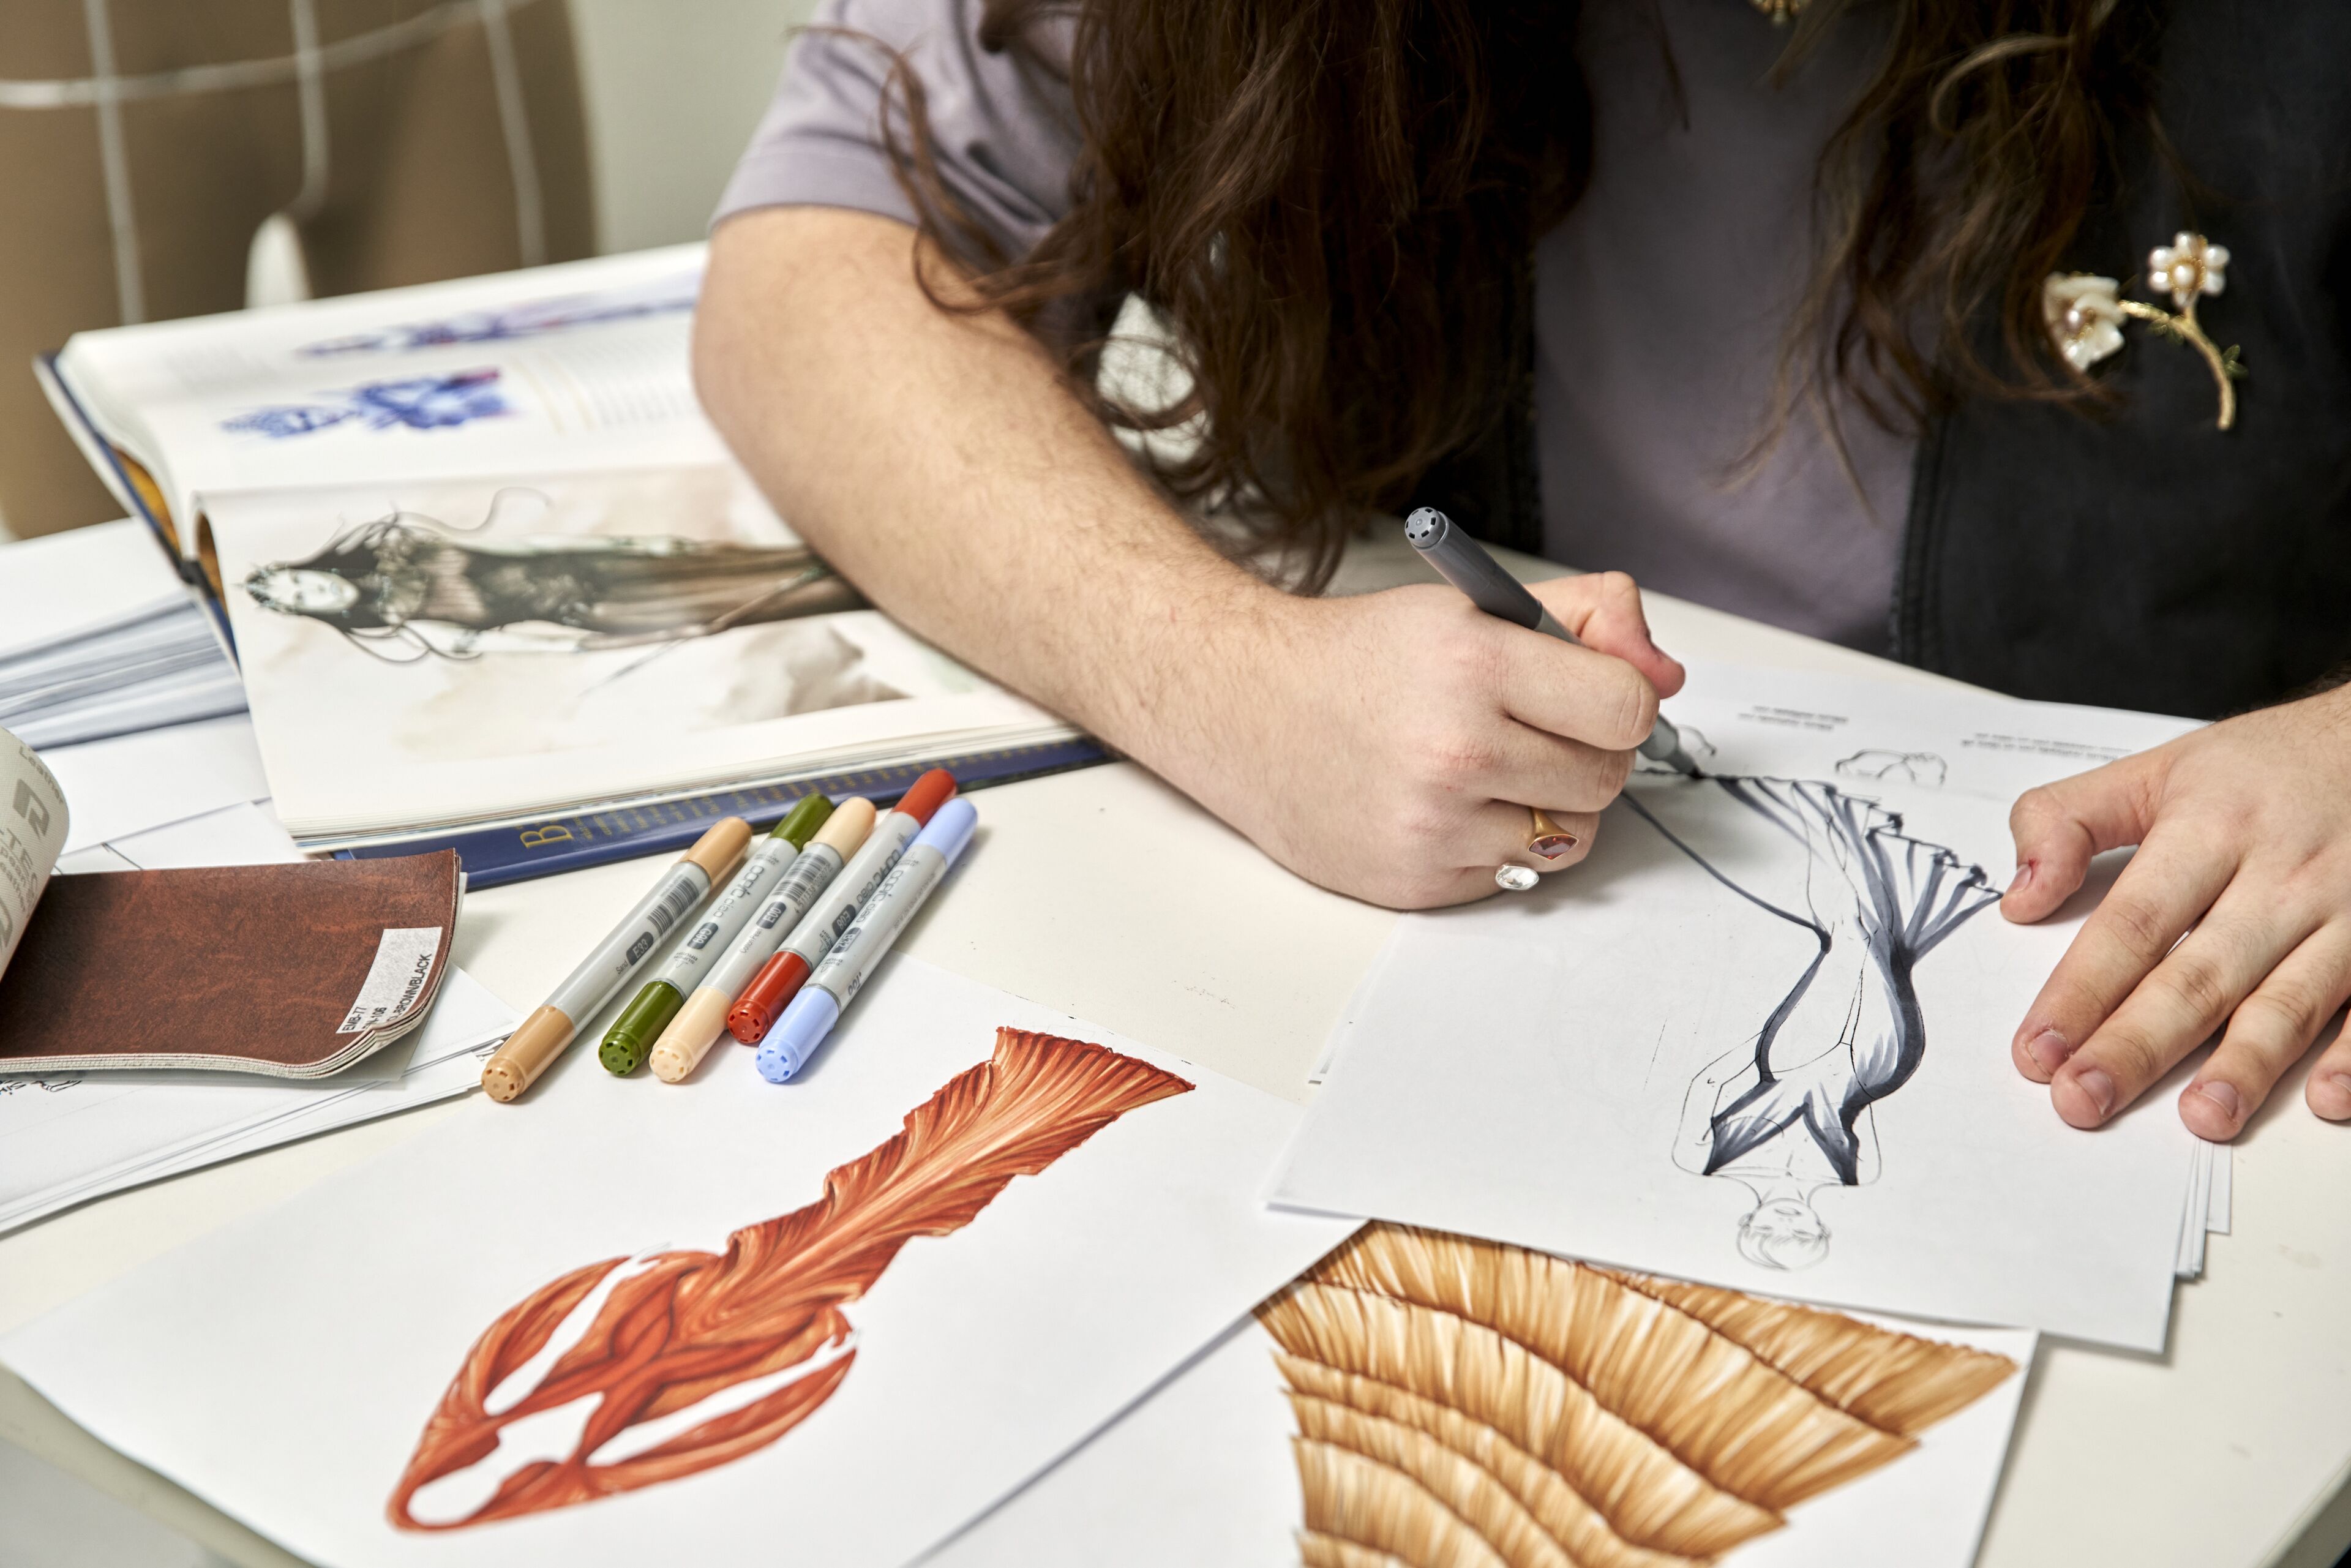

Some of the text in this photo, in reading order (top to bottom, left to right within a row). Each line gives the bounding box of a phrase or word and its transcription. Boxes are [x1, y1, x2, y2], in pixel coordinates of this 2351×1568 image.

[713, 898, 735, 918] ciao
[764, 906, 782, 923] E00
[836, 911, 851, 930] E08
[692, 928, 713, 944] G99
[632, 939, 650, 959] E33
[616, 959, 629, 975] Sand
[342, 1006, 367, 1032] EMB-77
